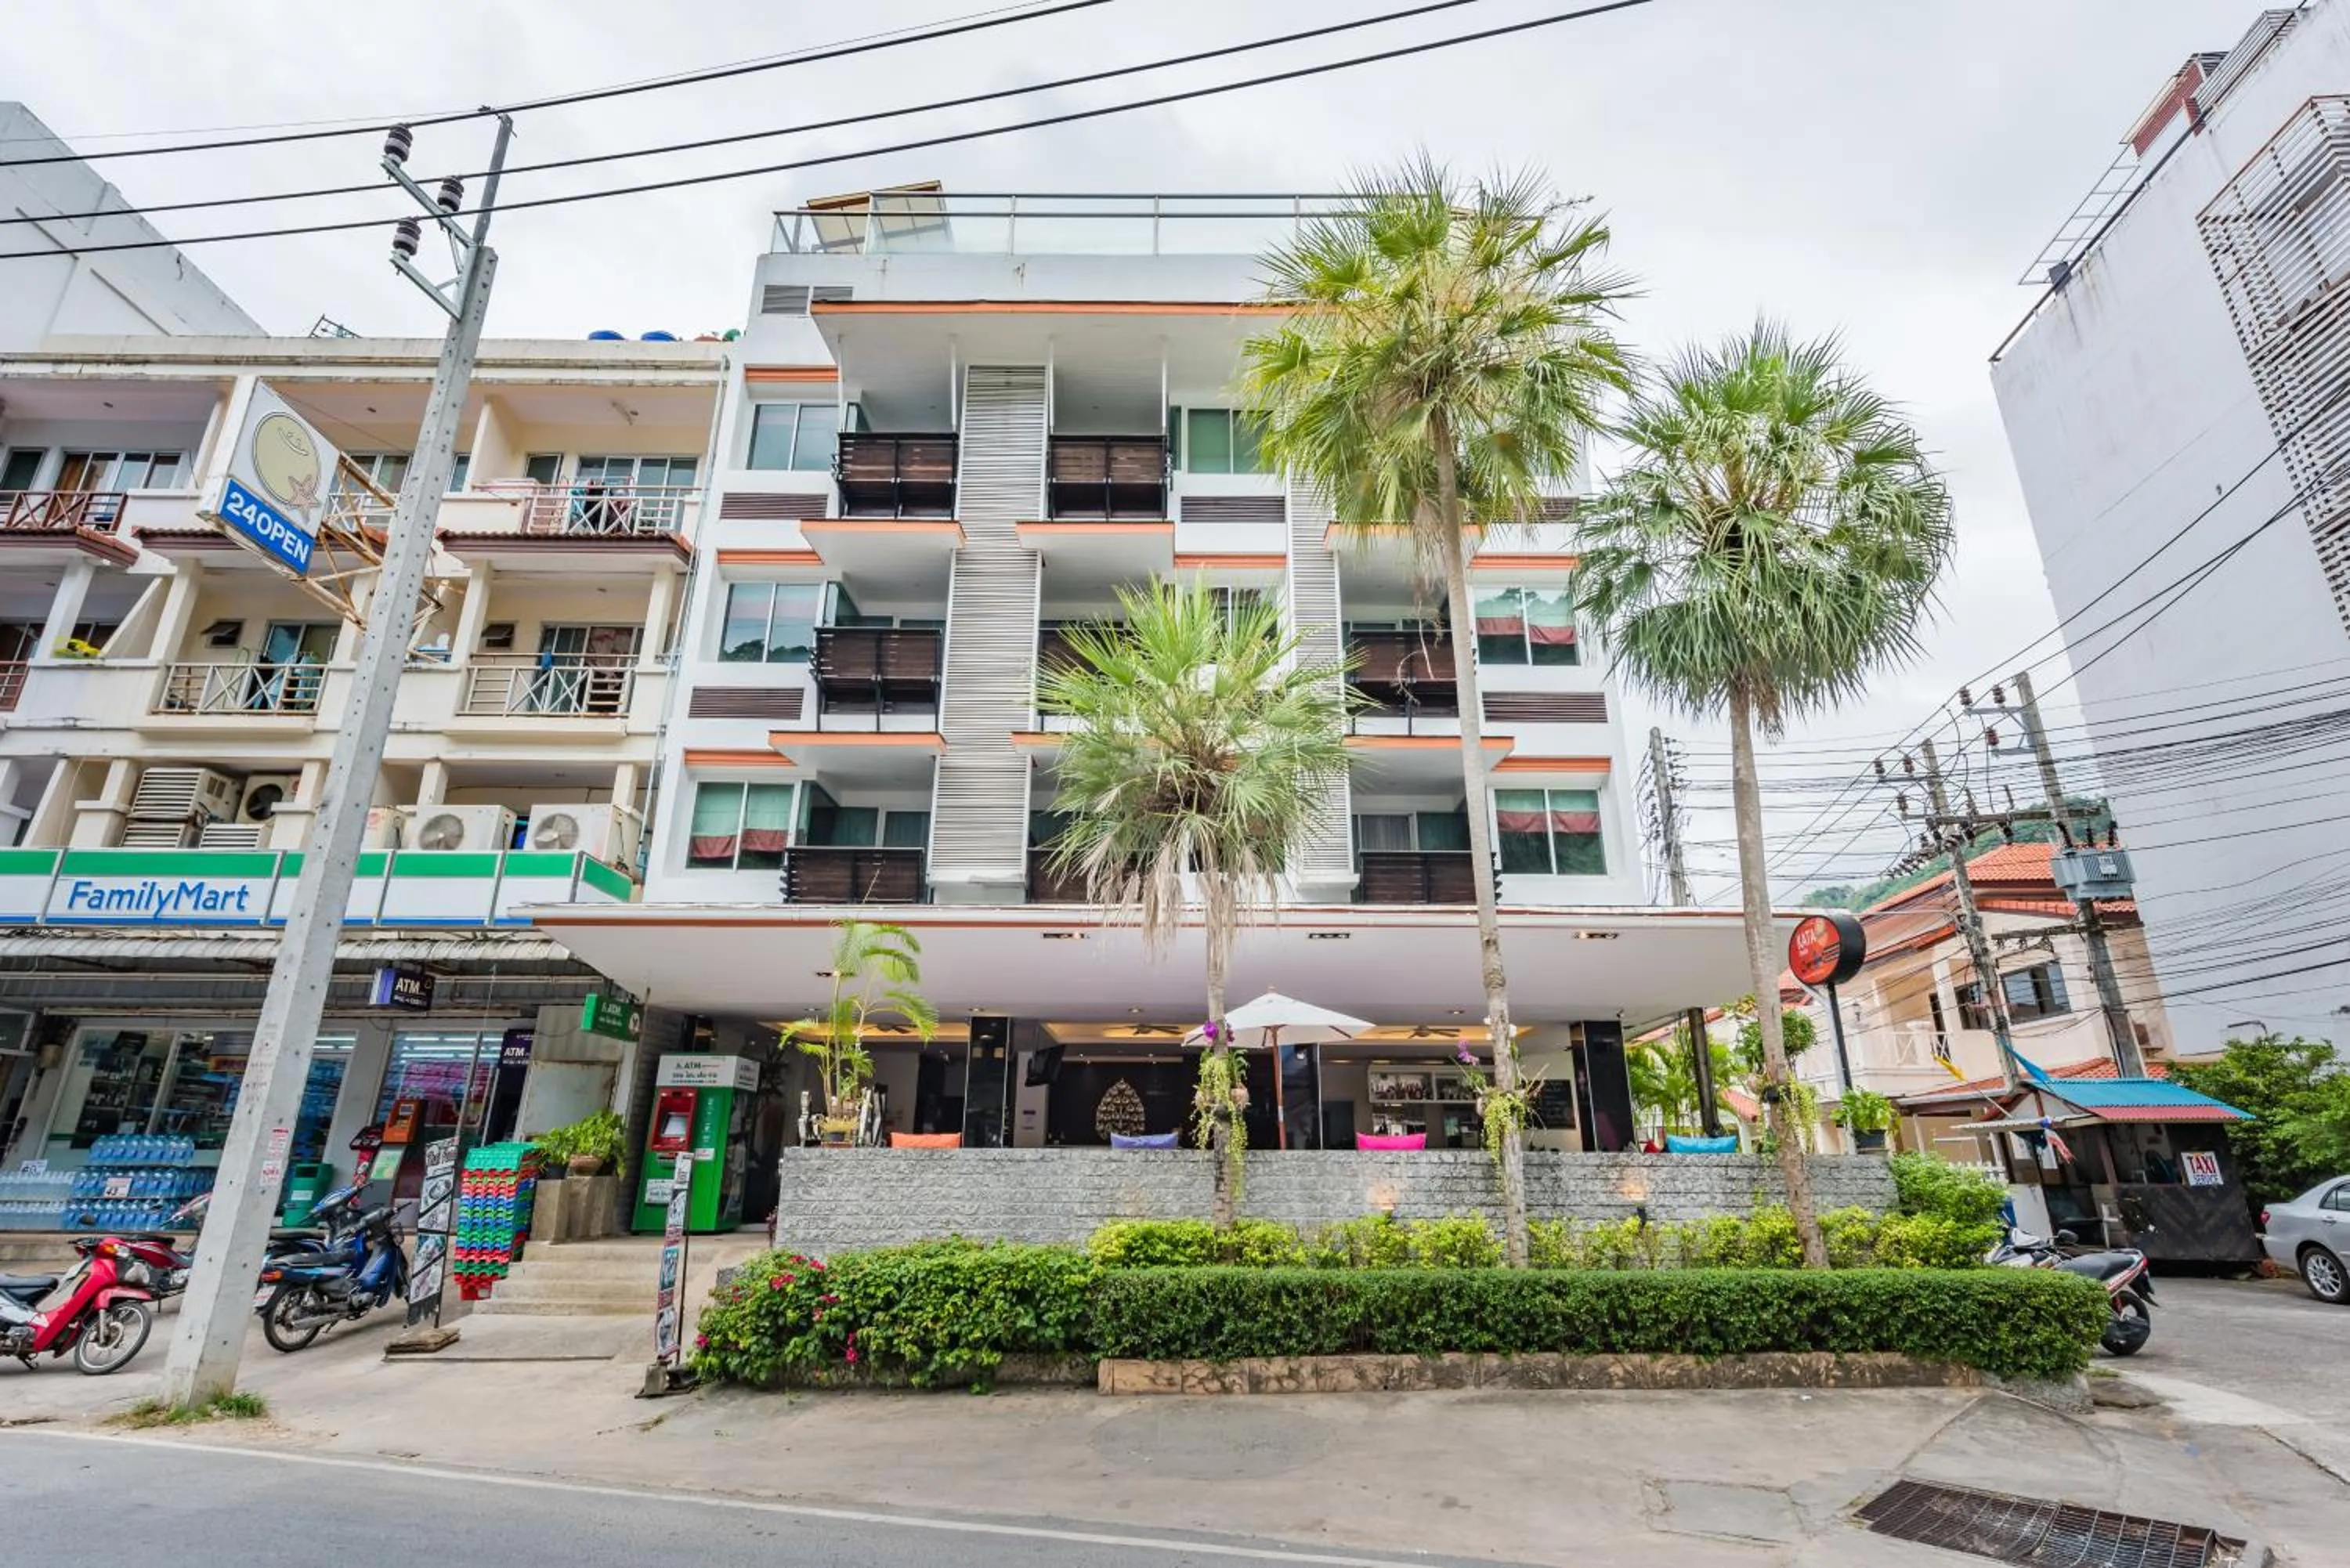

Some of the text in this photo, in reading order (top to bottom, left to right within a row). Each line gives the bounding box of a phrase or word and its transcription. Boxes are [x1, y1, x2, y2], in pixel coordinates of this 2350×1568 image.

[67, 880, 250, 919] FamilyMart
[394, 977, 421, 994] ATM
[504, 1047, 526, 1057] ATM
[2186, 1155, 2216, 1174] TAXI
